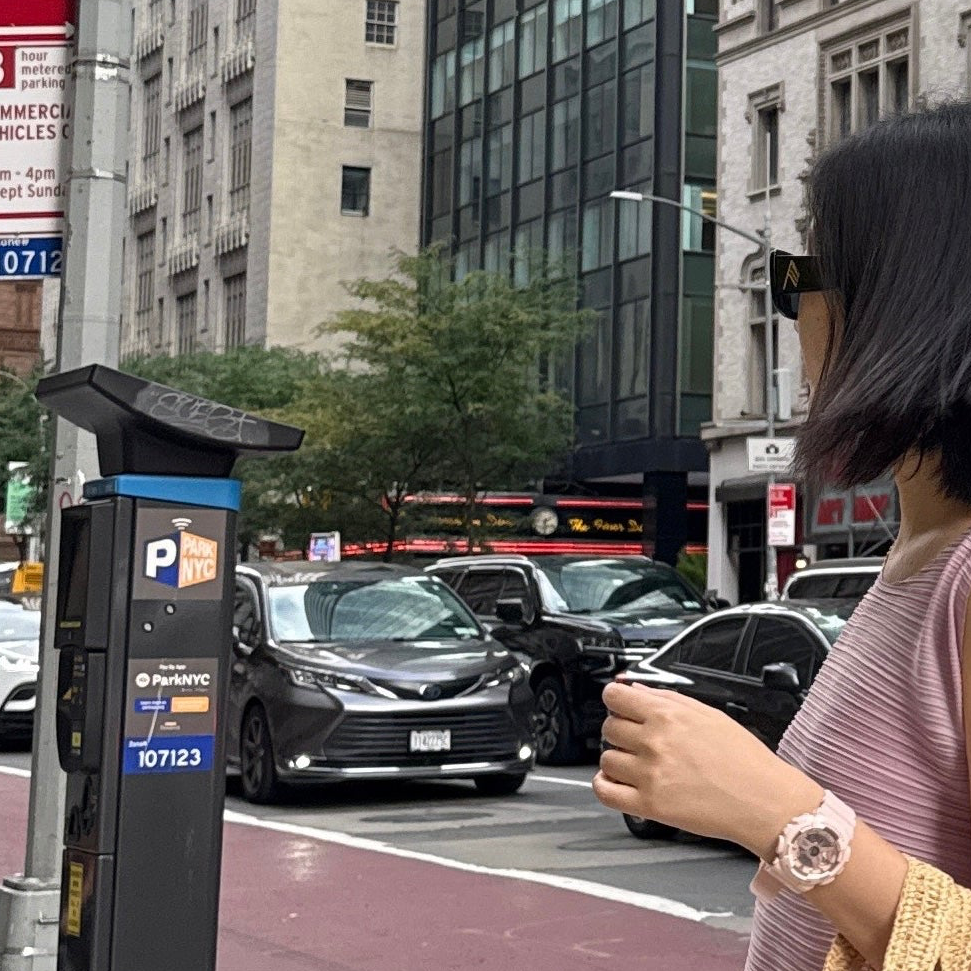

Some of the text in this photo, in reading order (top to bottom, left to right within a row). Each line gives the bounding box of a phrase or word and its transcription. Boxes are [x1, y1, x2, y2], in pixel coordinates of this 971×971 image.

[21, 50, 48, 62] hour
[21, 63, 71, 76] metered
[21, 77, 66, 92] parking
[25, 167, 56, 182] 4pm
[182, 536, 214, 557] PARK
[145, 538, 178, 579] P
[182, 558, 214, 581] NYC
[152, 673, 211, 687] ParkNYC
[138, 748, 202, 769] 107123
